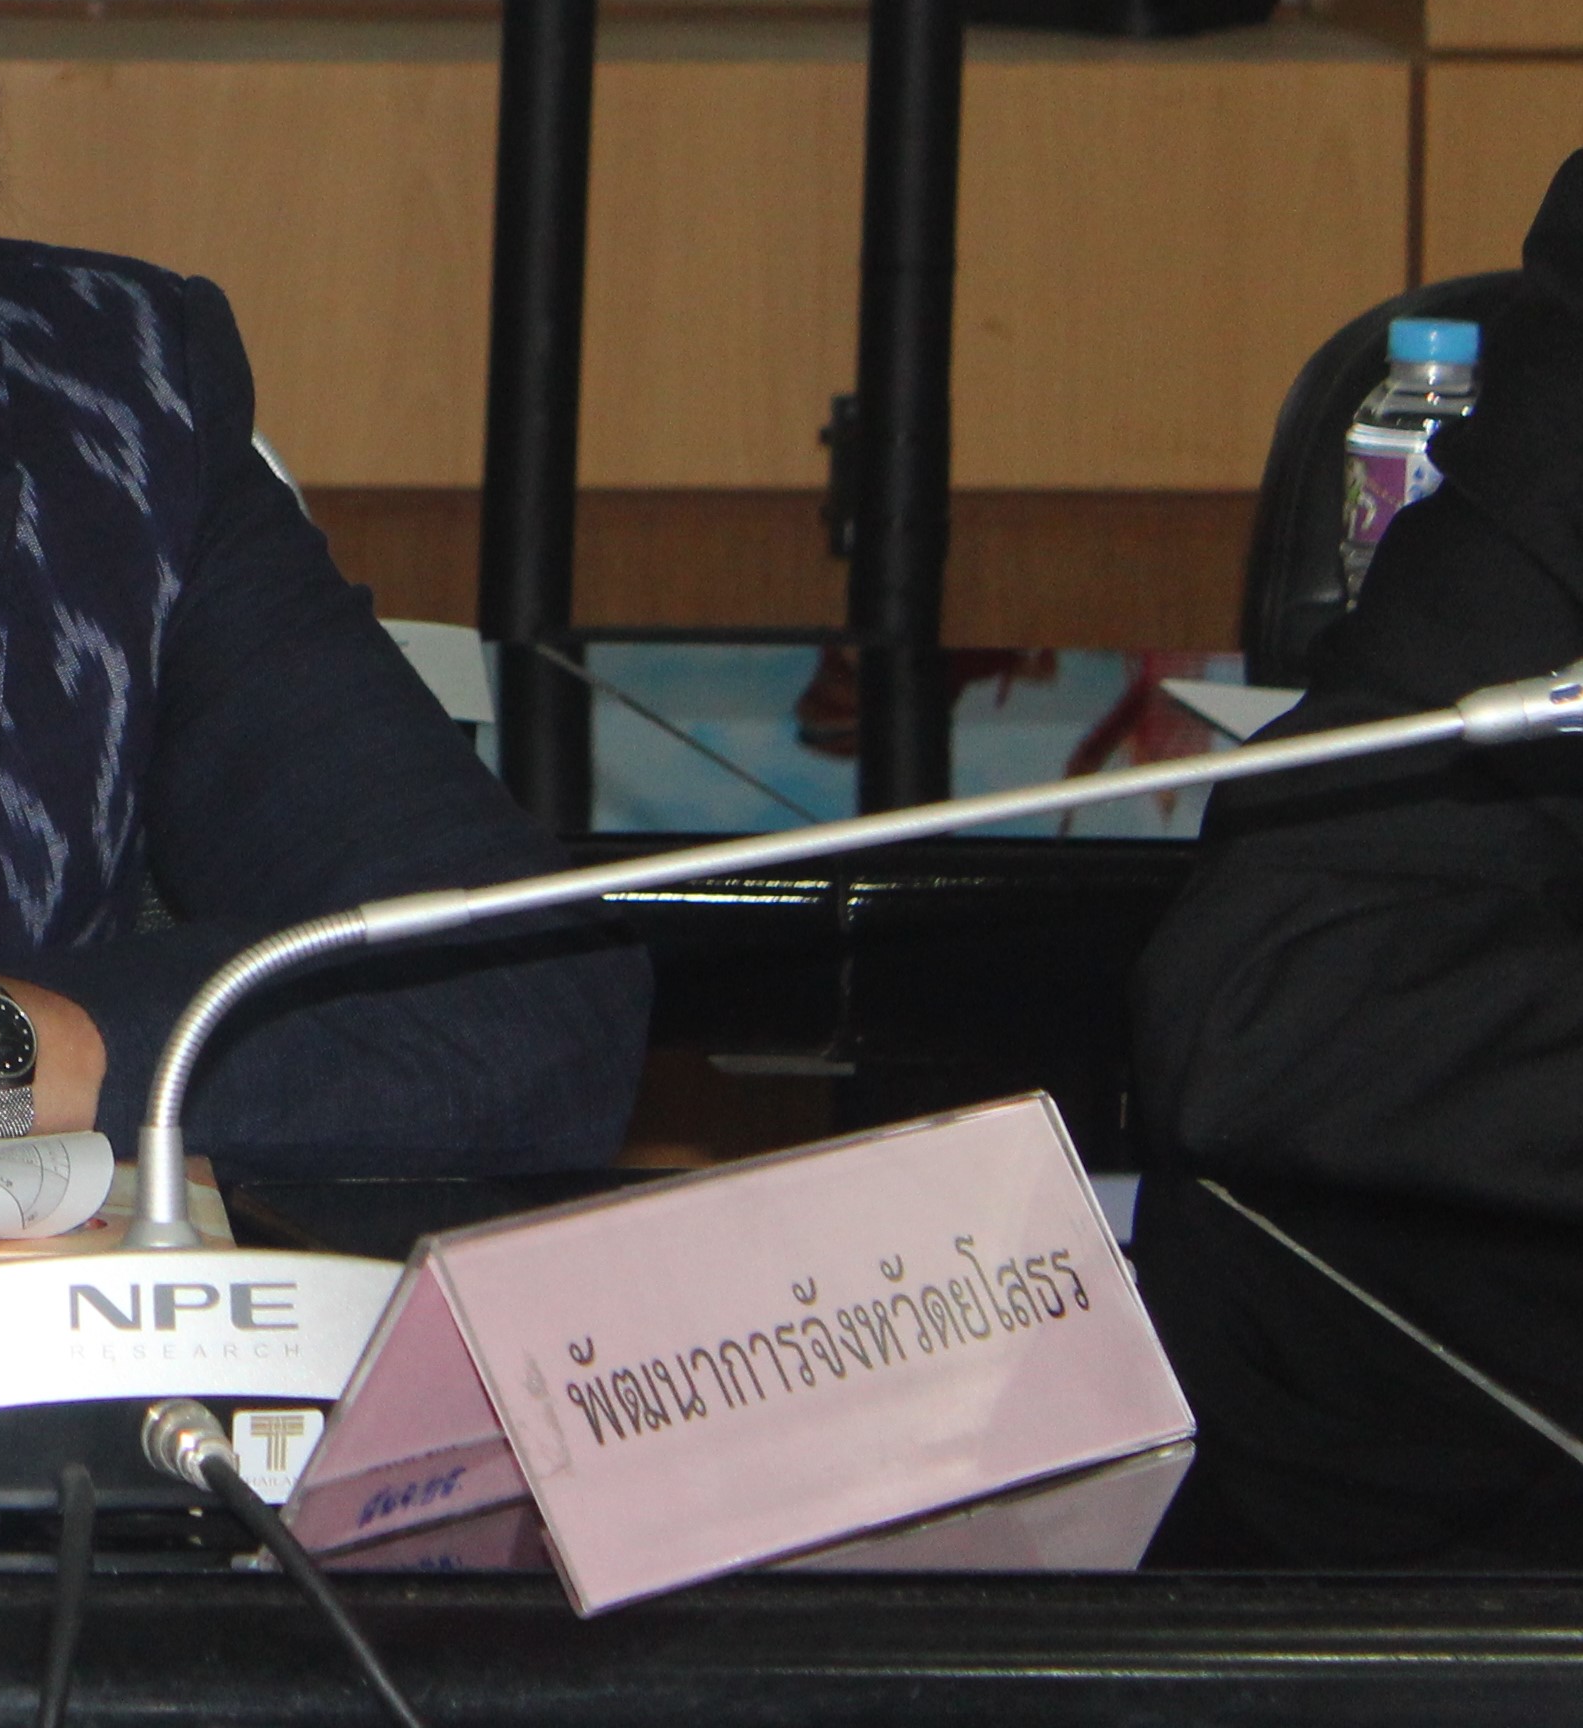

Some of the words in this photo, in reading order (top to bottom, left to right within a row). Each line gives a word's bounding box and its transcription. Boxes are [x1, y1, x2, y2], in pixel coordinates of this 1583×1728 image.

[69, 1282, 299, 1332] NPE
[70, 1343, 300, 1359] RESEARCH
[565, 1234, 1090, 1446] พัฒนาการจังหวัดยโสธร
